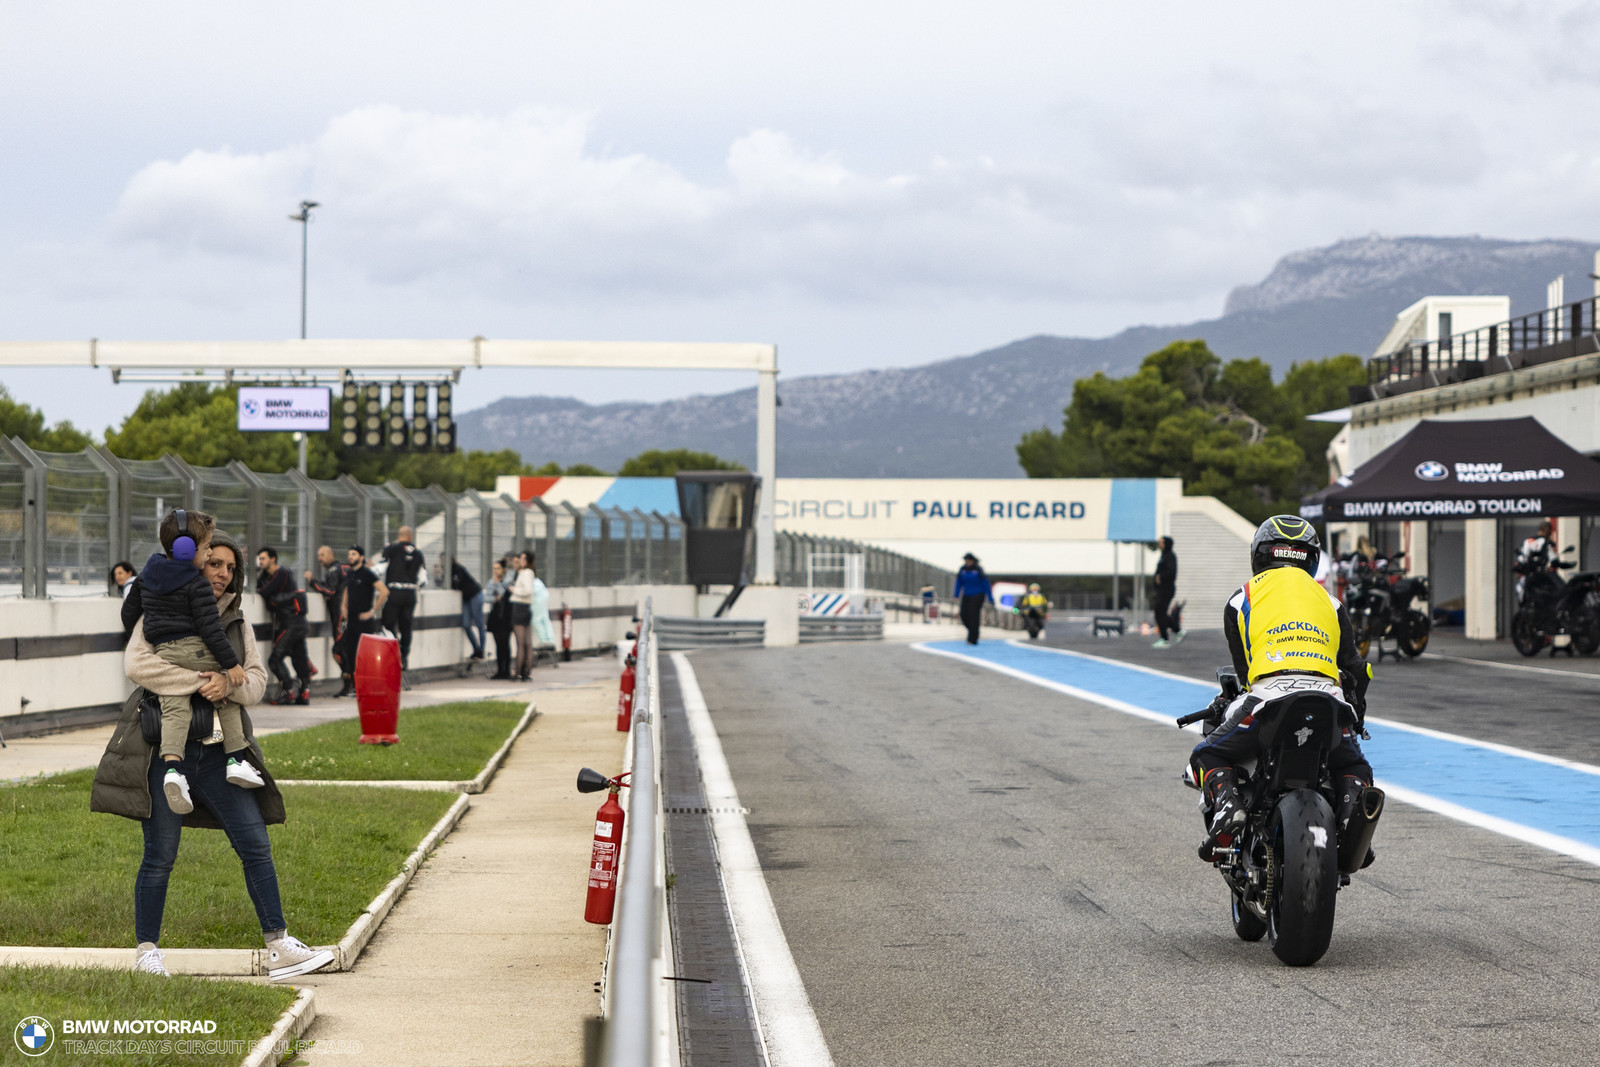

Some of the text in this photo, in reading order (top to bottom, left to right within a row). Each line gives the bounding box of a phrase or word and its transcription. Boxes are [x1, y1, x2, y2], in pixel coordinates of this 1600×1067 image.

[265, 399, 293, 408] BMW
[265, 410, 328, 419] MOTORRAD
[1455, 462, 1503, 473] BMW
[1457, 468, 1565, 483] MOTORRAD
[774, 499, 1086, 519] CIRCUIT PAUL RICARD
[1344, 498, 1542, 517] BMW MOTORRAD TOULON
[1266, 621, 1330, 643] TRACKDAYS
[1276, 635, 1295, 644] BMW
[1285, 651, 1333, 664] MICHELIN
